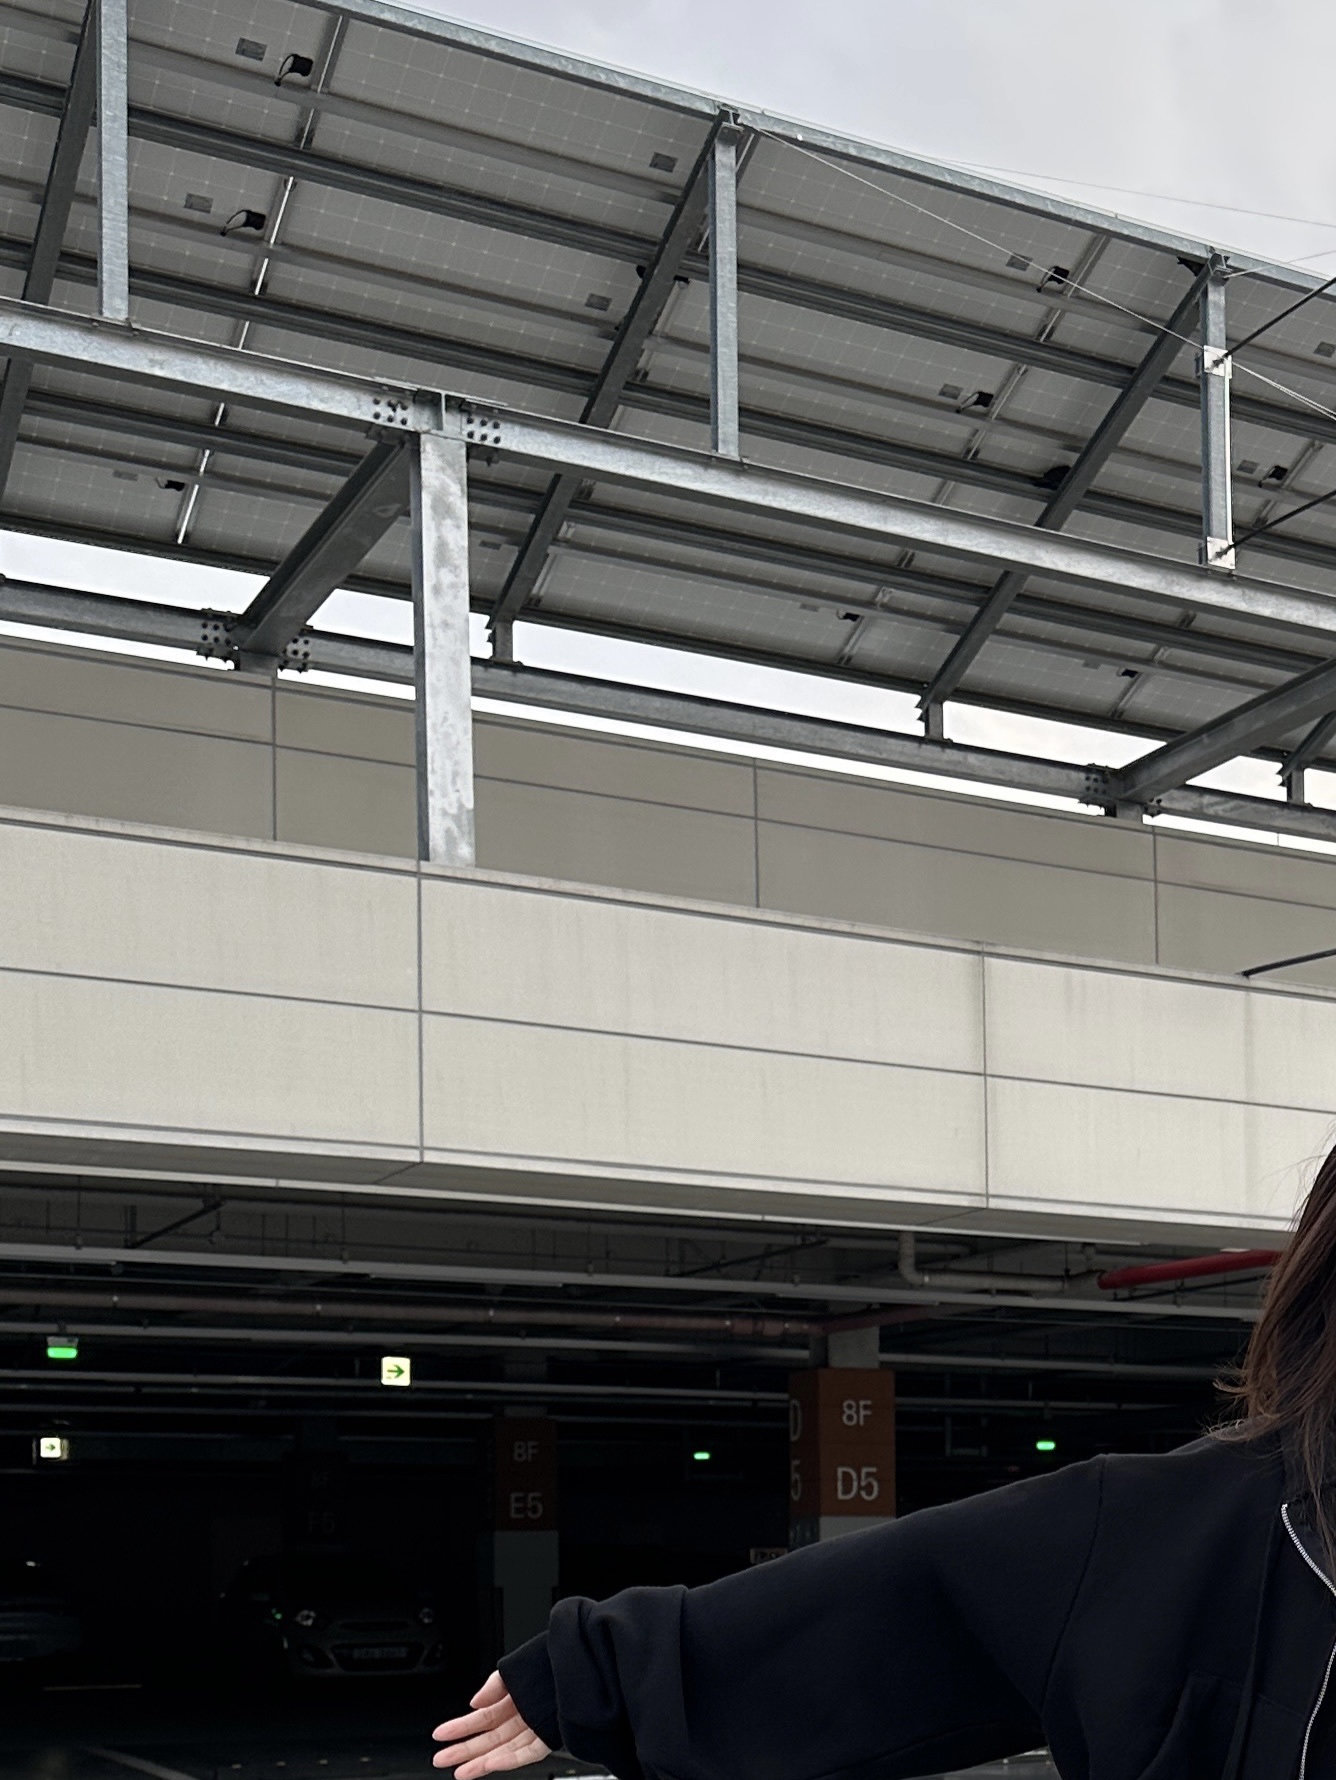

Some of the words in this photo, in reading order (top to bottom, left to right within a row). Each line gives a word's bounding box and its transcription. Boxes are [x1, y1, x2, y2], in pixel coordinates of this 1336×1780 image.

[841, 1399, 873, 1427] 8F
[512, 1440, 540, 1462] 8F
[836, 1465, 880, 1502] D5
[509, 1491, 544, 1520] E5
